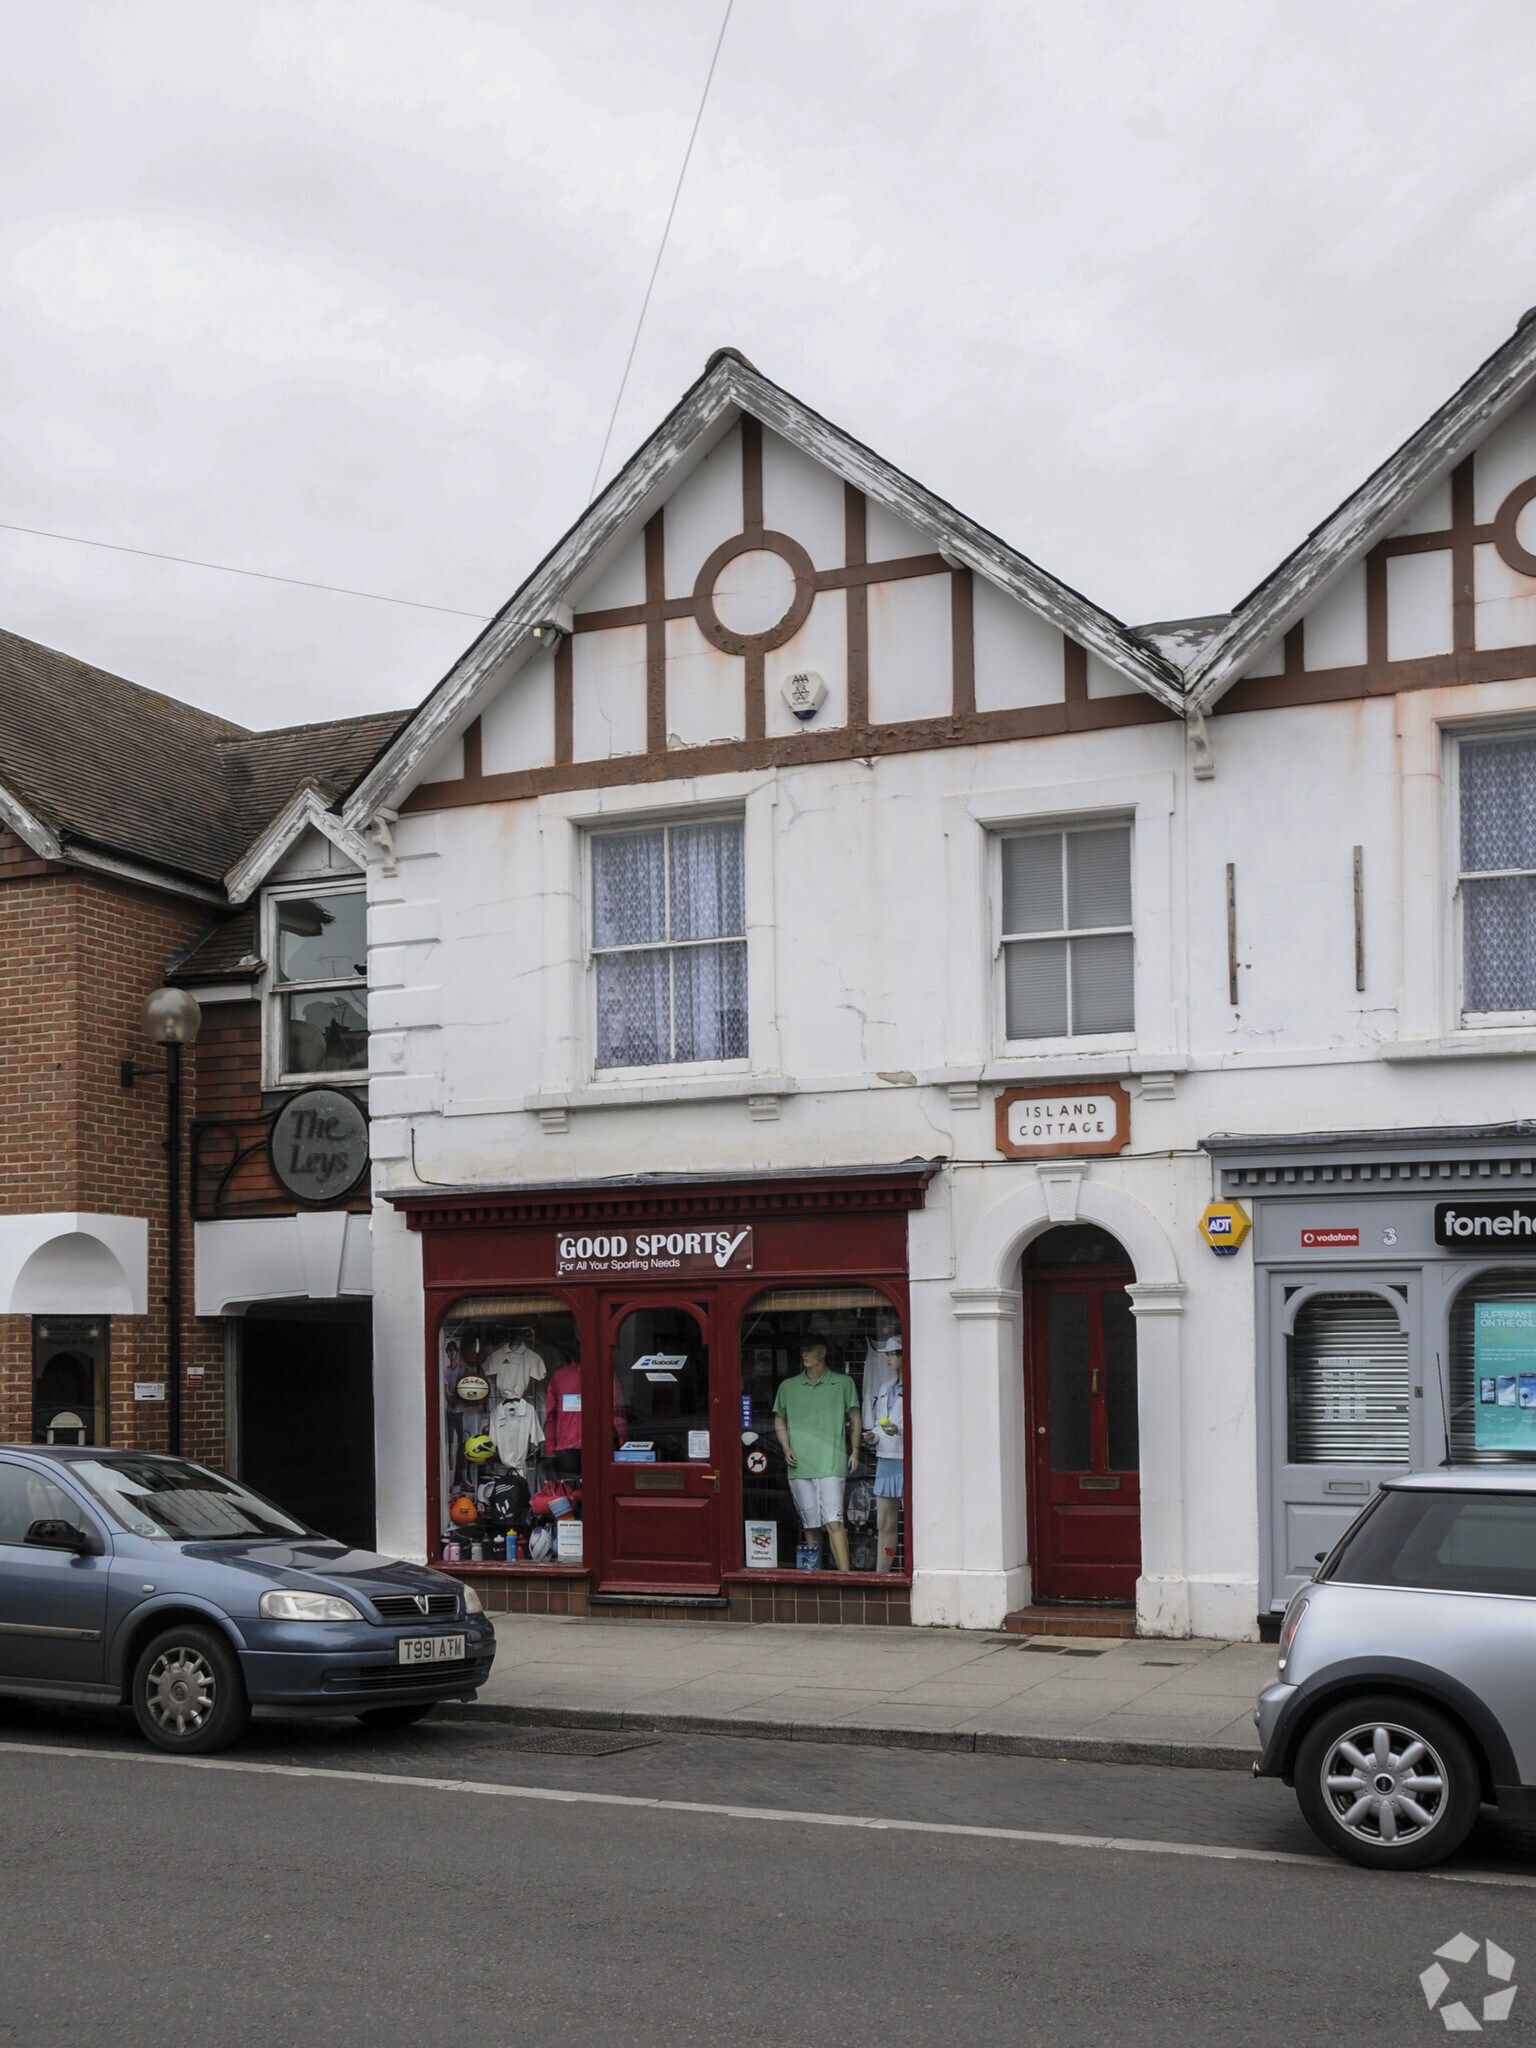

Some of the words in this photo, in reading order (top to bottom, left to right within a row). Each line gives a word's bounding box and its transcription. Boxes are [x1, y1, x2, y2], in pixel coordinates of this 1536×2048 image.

[1025, 1103, 1097, 1118] ISLAND
[290, 1107, 357, 1141] The
[1019, 1121, 1104, 1136] COTTAGE
[288, 1143, 348, 1183] Leys
[1208, 1218, 1232, 1233] ADT
[1444, 1209, 1536, 1236] foneh
[1316, 1232, 1358, 1243] vodafone
[1381, 1227, 1398, 1246] 3
[559, 1236, 628, 1259] GOOD
[635, 1231, 731, 1256] SPORTS
[559, 1261, 574, 1271] For
[576, 1260, 587, 1270] All
[589, 1260, 608, 1270] Your
[611, 1259, 649, 1270] Sporting
[650, 1258, 680, 1268] Needs
[1480, 1310, 1533, 1319] SUPERFAST
[1480, 1319, 1496, 1327] ON
[1497, 1319, 1515, 1327] THE
[404, 1640, 435, 1660] T991
